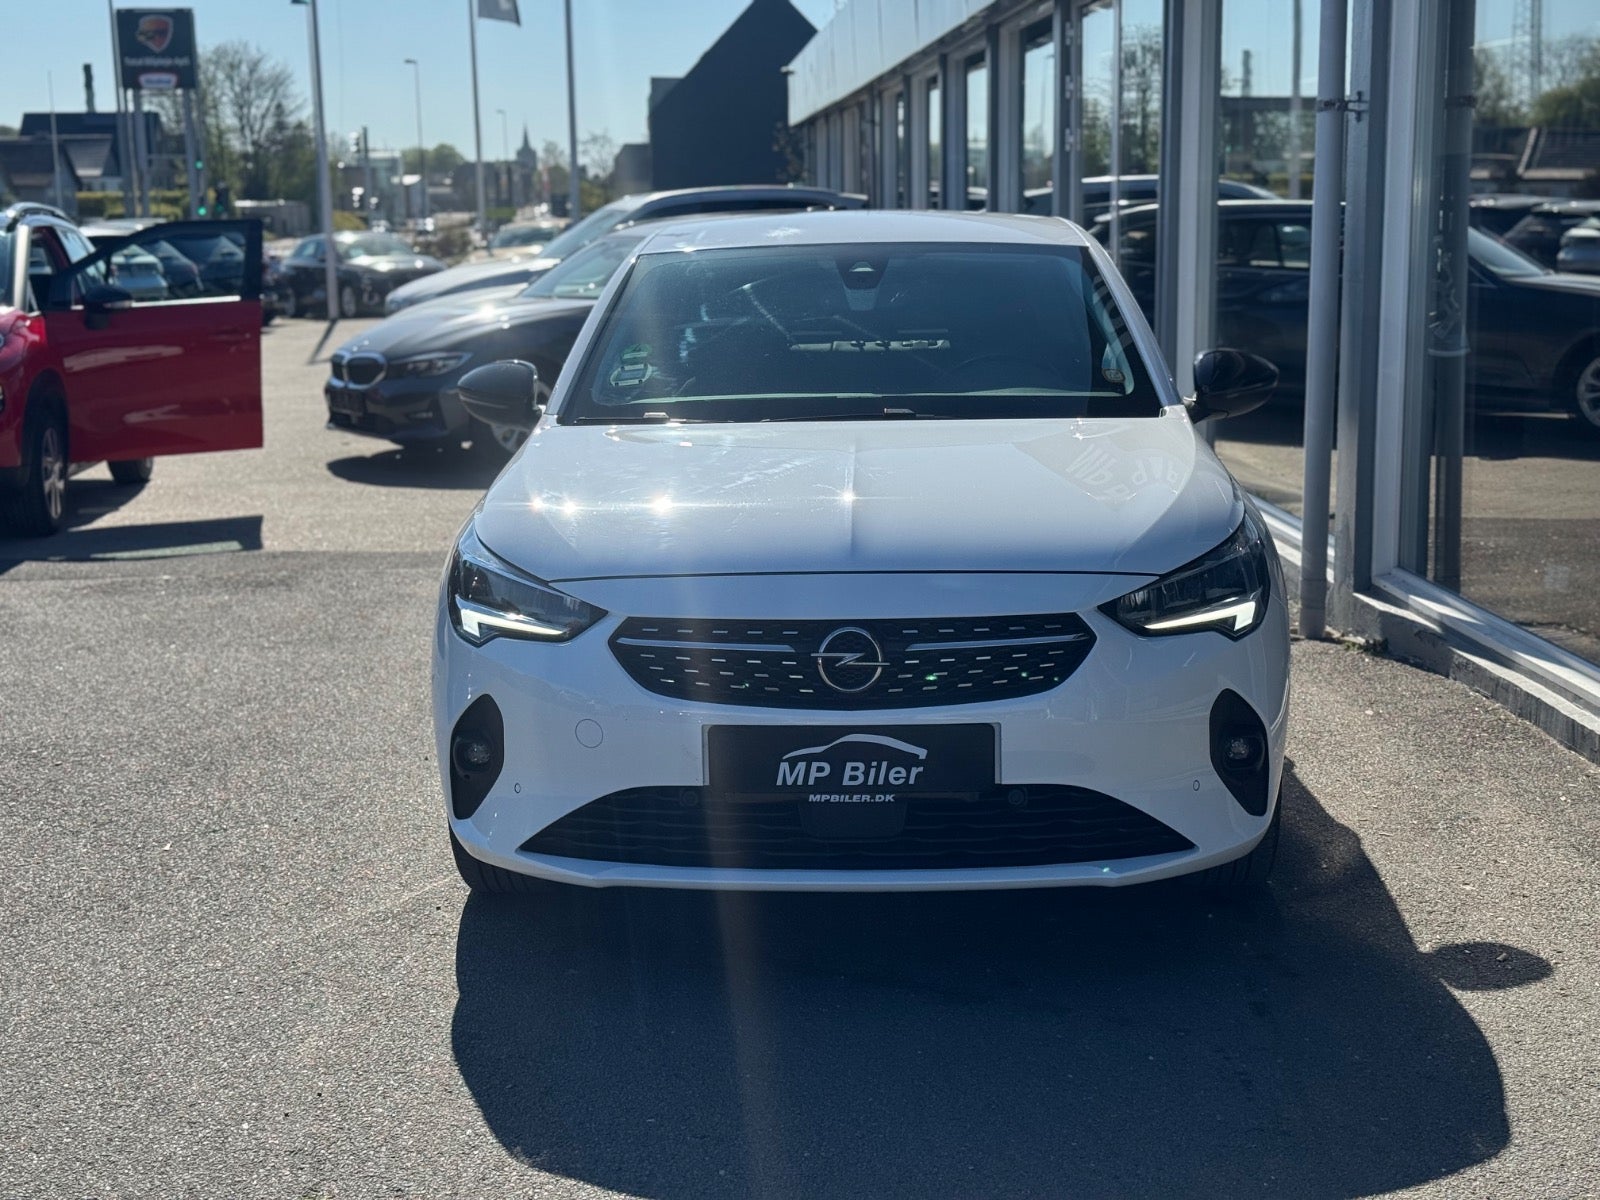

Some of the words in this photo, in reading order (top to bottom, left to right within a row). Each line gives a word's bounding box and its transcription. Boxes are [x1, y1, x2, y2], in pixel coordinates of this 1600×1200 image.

[776, 761, 831, 786] MP
[842, 761, 924, 786] Biler
[808, 793, 896, 803] MPBILER.DK
